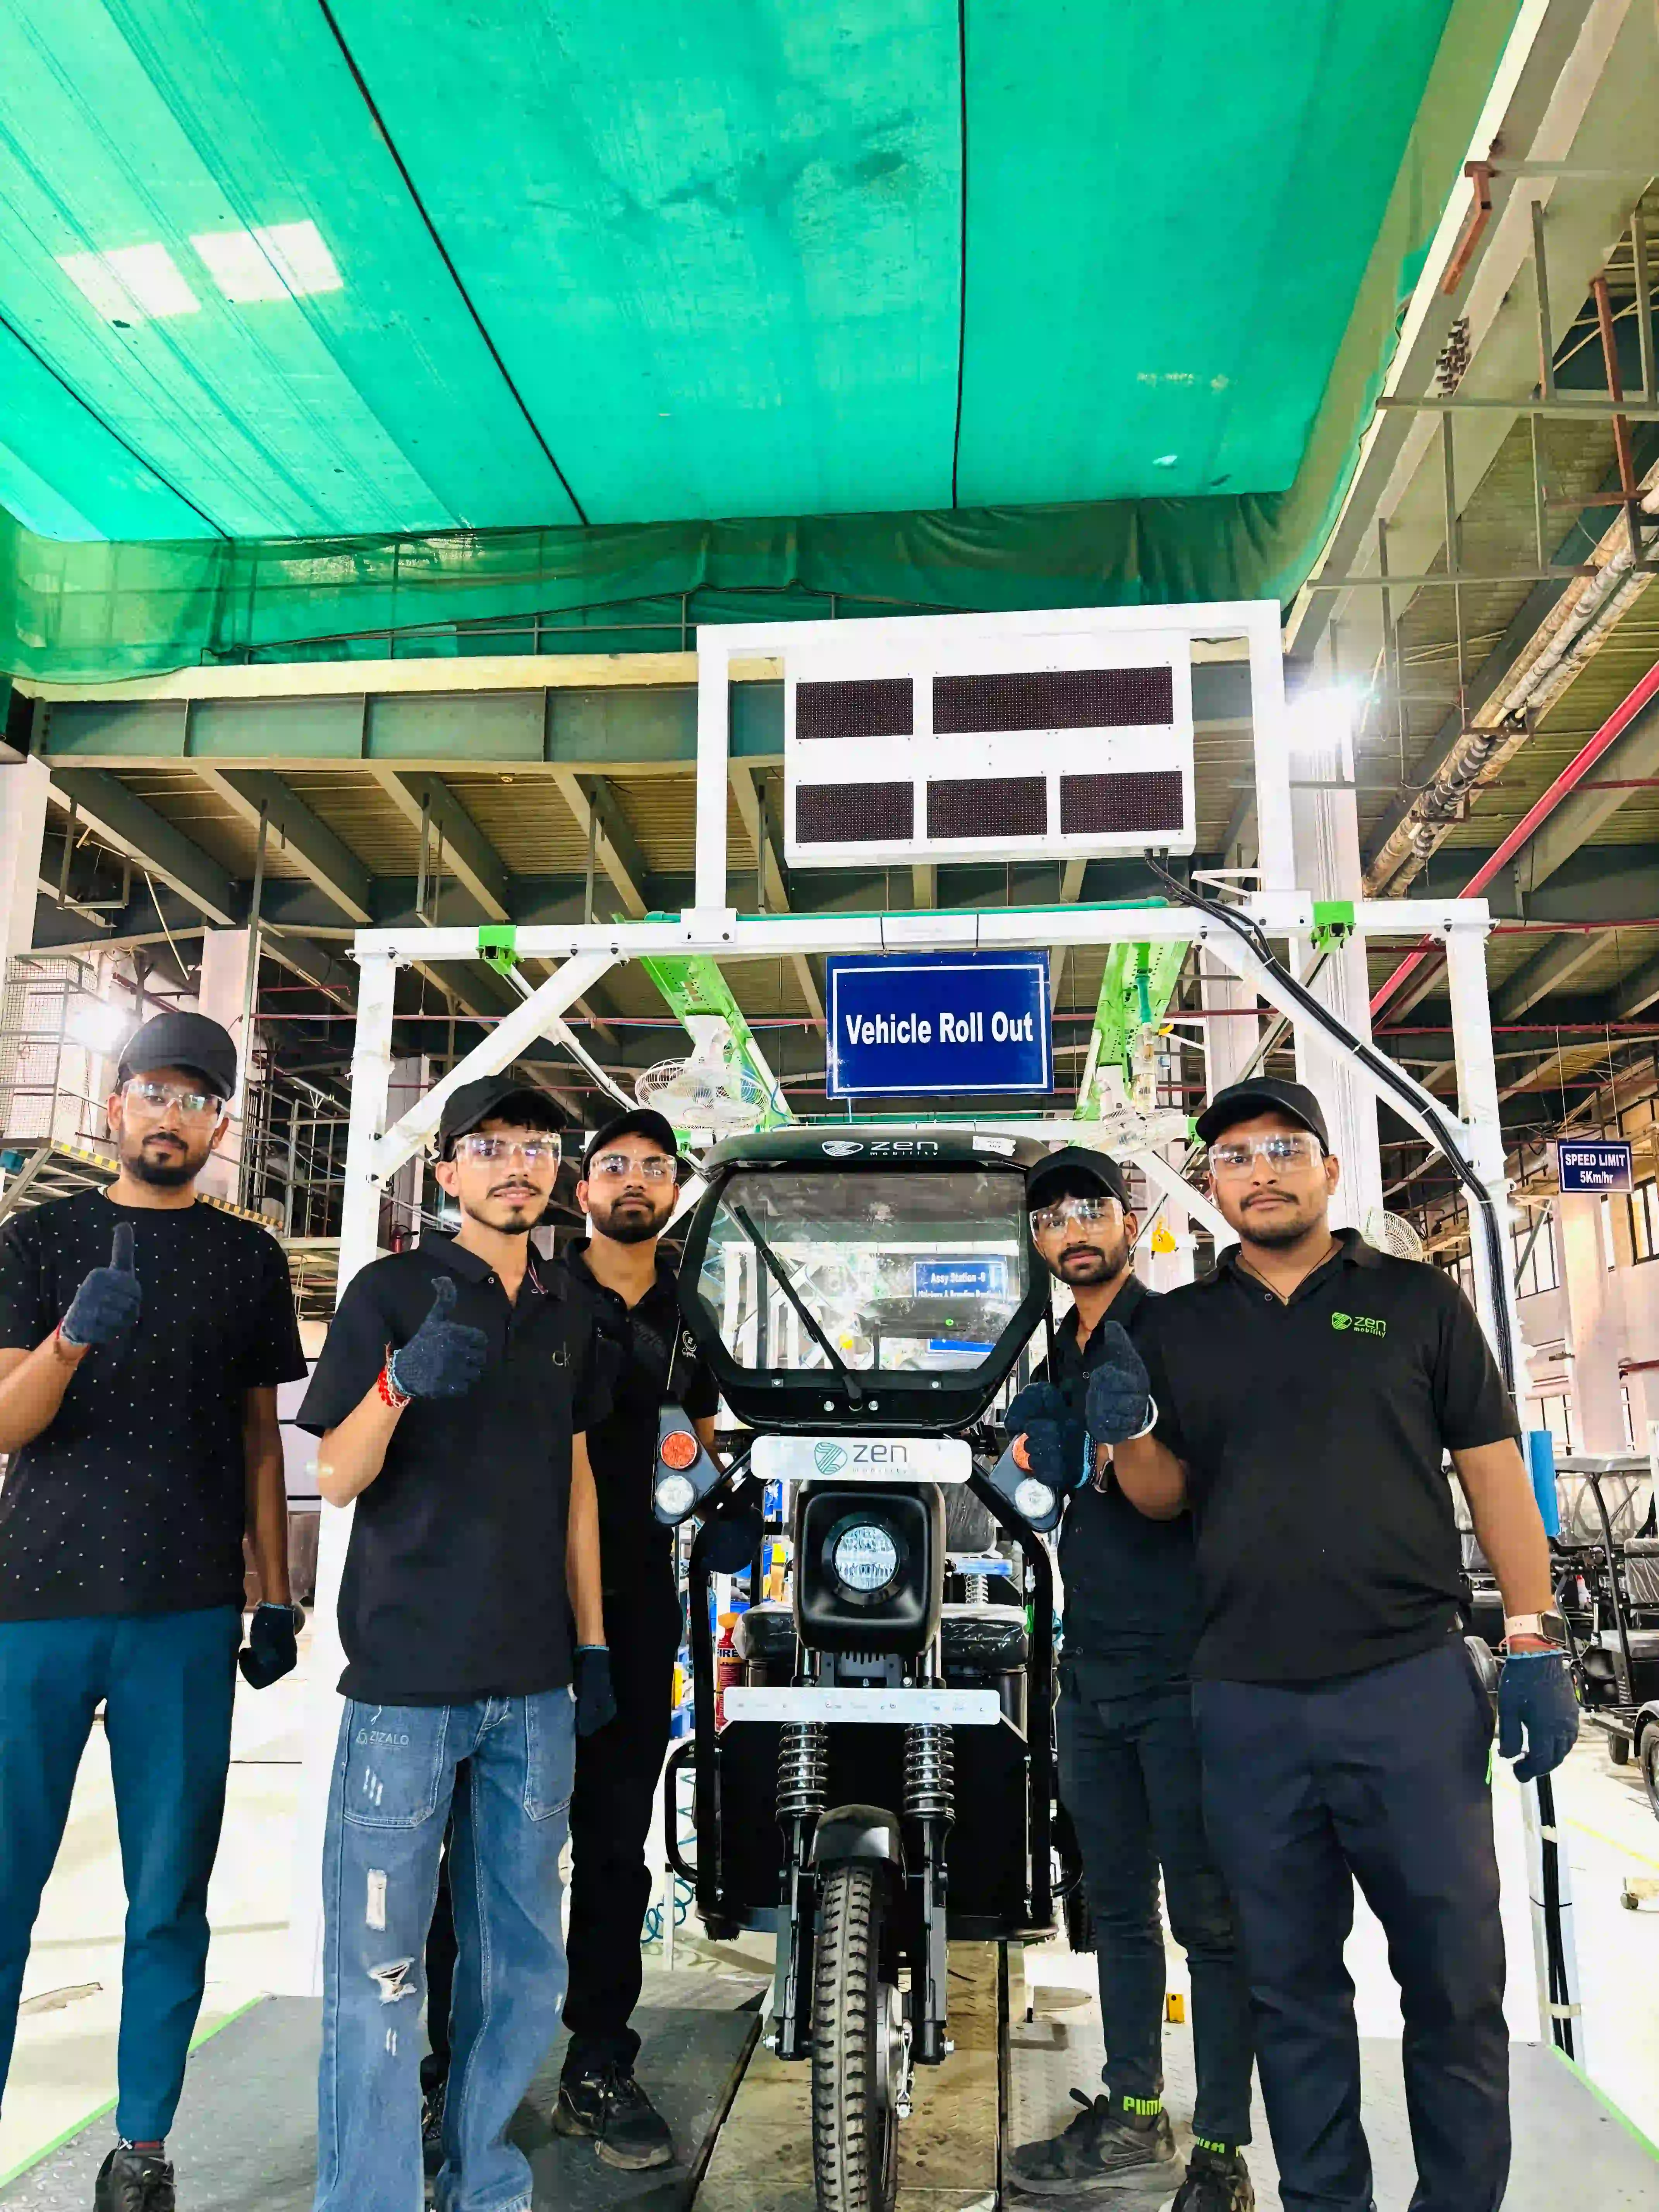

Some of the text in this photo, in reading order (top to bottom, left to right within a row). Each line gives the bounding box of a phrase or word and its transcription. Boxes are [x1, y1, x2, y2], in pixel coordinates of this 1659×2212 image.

[845, 1011, 1033, 1044] Vehicle Roll Out
[870, 1142, 938, 1151] zen
[1565, 1154, 1625, 1166] SPEED LIMIT
[1580, 1171, 1613, 1184] 5Km/hr
[950, 1272, 976, 1283] Station
[1354, 1317, 1386, 1331] zen
[1354, 1327, 1386, 1338] mobility
[853, 1445, 907, 1463] zen
[370, 1731, 409, 1745] ZIZALO
